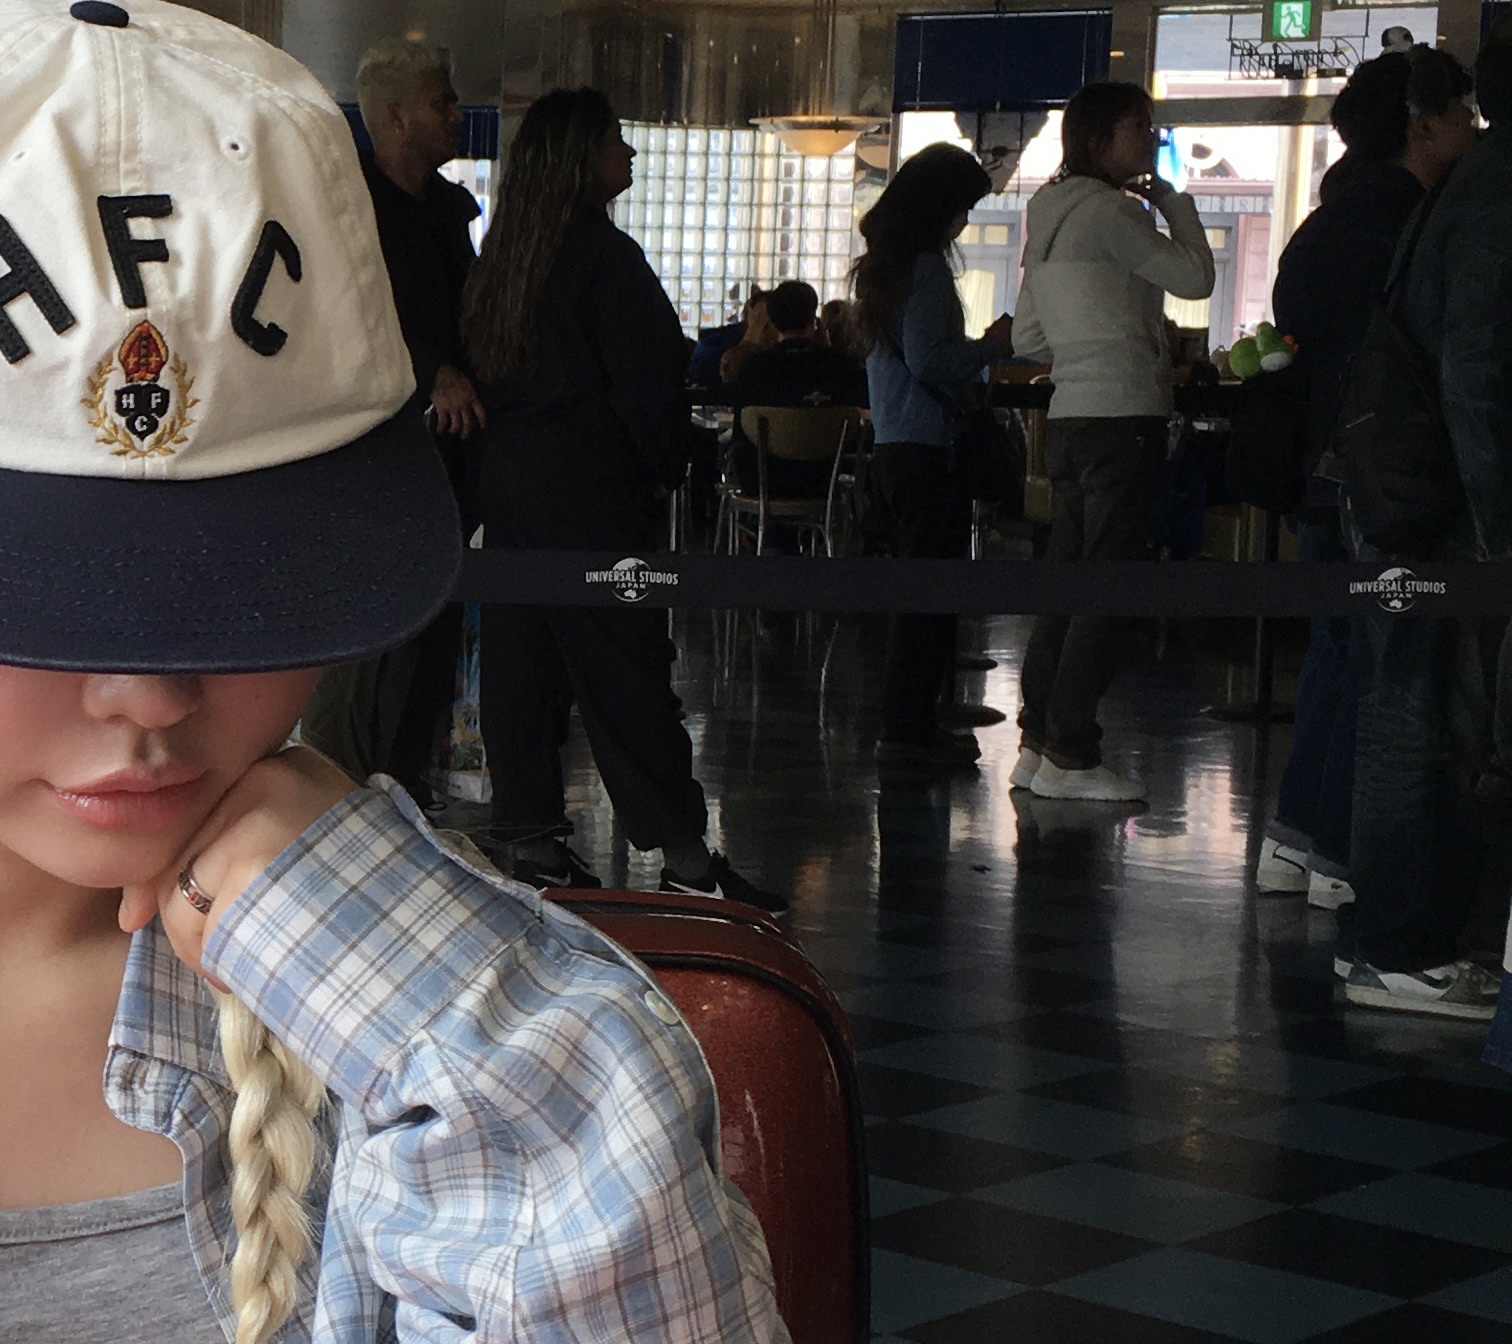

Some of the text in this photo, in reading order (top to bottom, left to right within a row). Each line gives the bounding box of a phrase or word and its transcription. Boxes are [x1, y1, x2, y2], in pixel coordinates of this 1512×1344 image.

[585, 570, 679, 585] UNIVERSAL STUDIOS
[1349, 580, 1446, 594] UNIVERSAL STUDIOS
